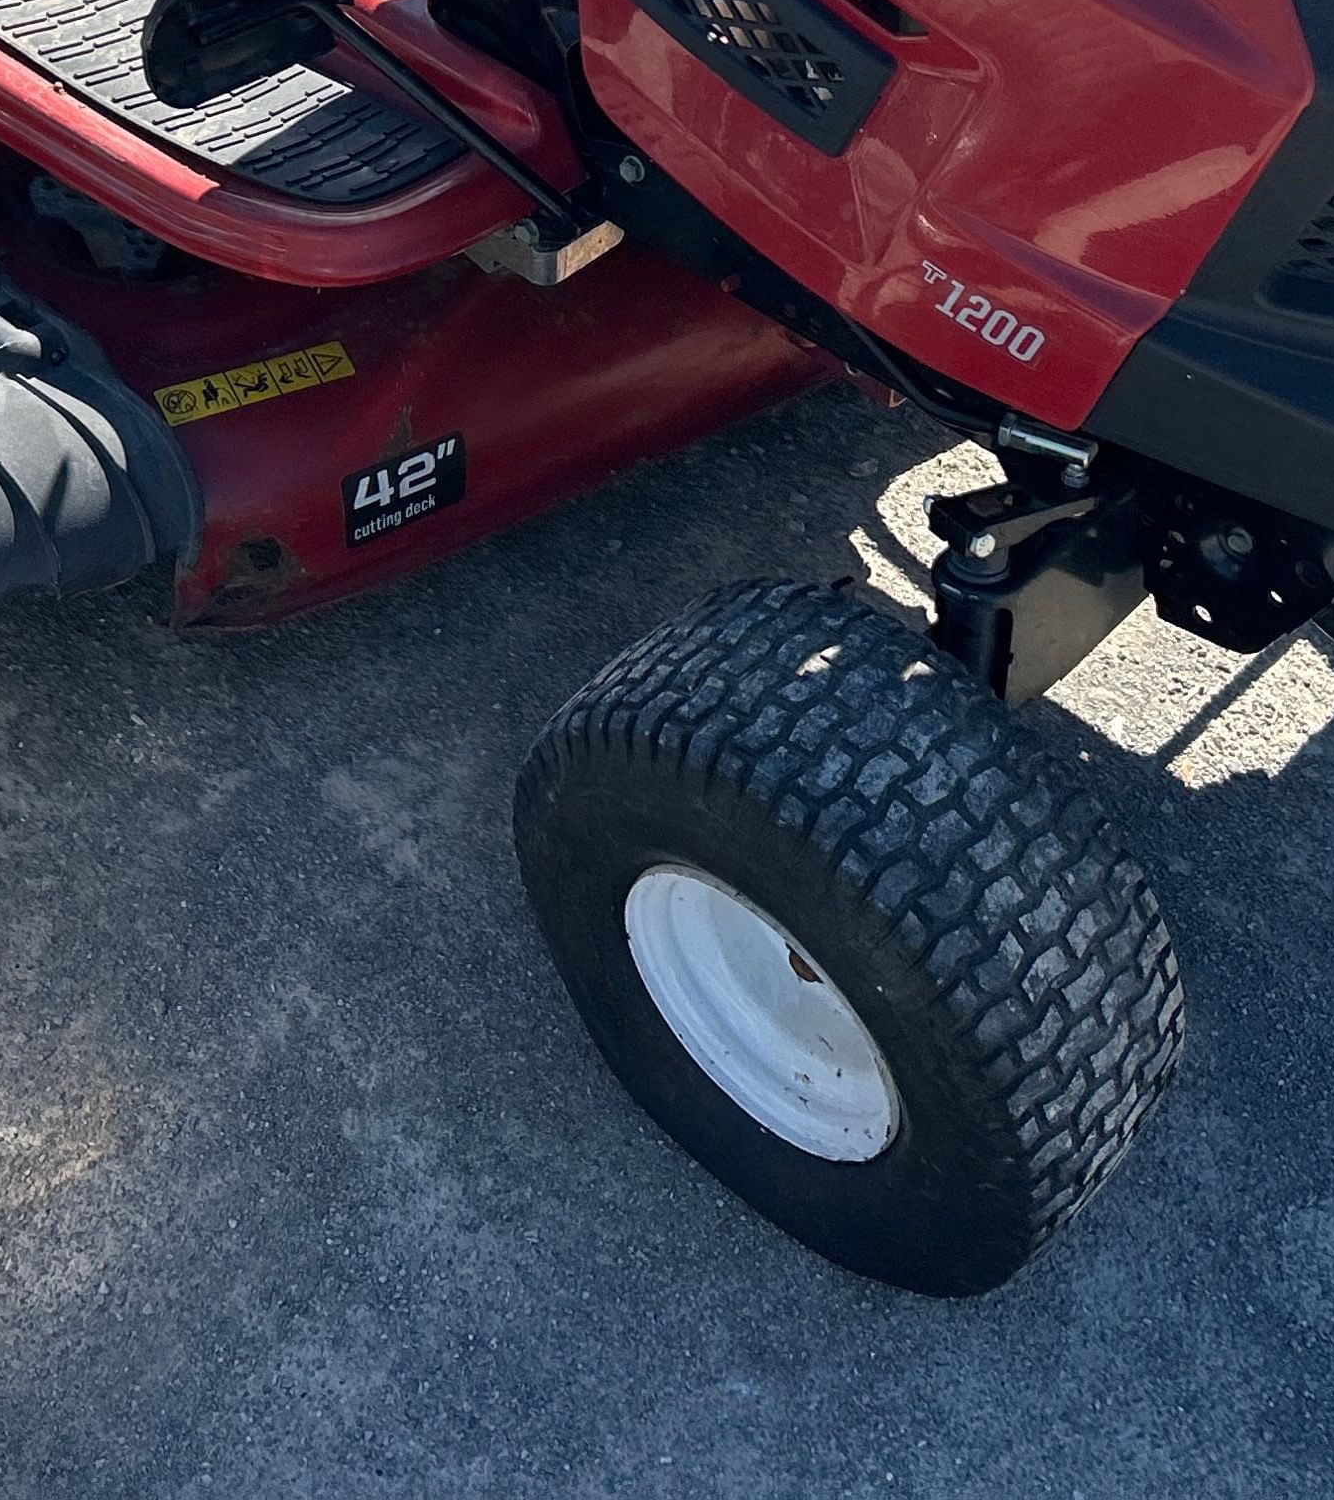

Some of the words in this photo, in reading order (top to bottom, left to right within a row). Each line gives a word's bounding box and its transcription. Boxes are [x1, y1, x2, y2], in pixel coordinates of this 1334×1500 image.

[353, 438, 456, 510] 42"
[354, 510, 402, 541] cutting
[405, 493, 436, 518] deck
